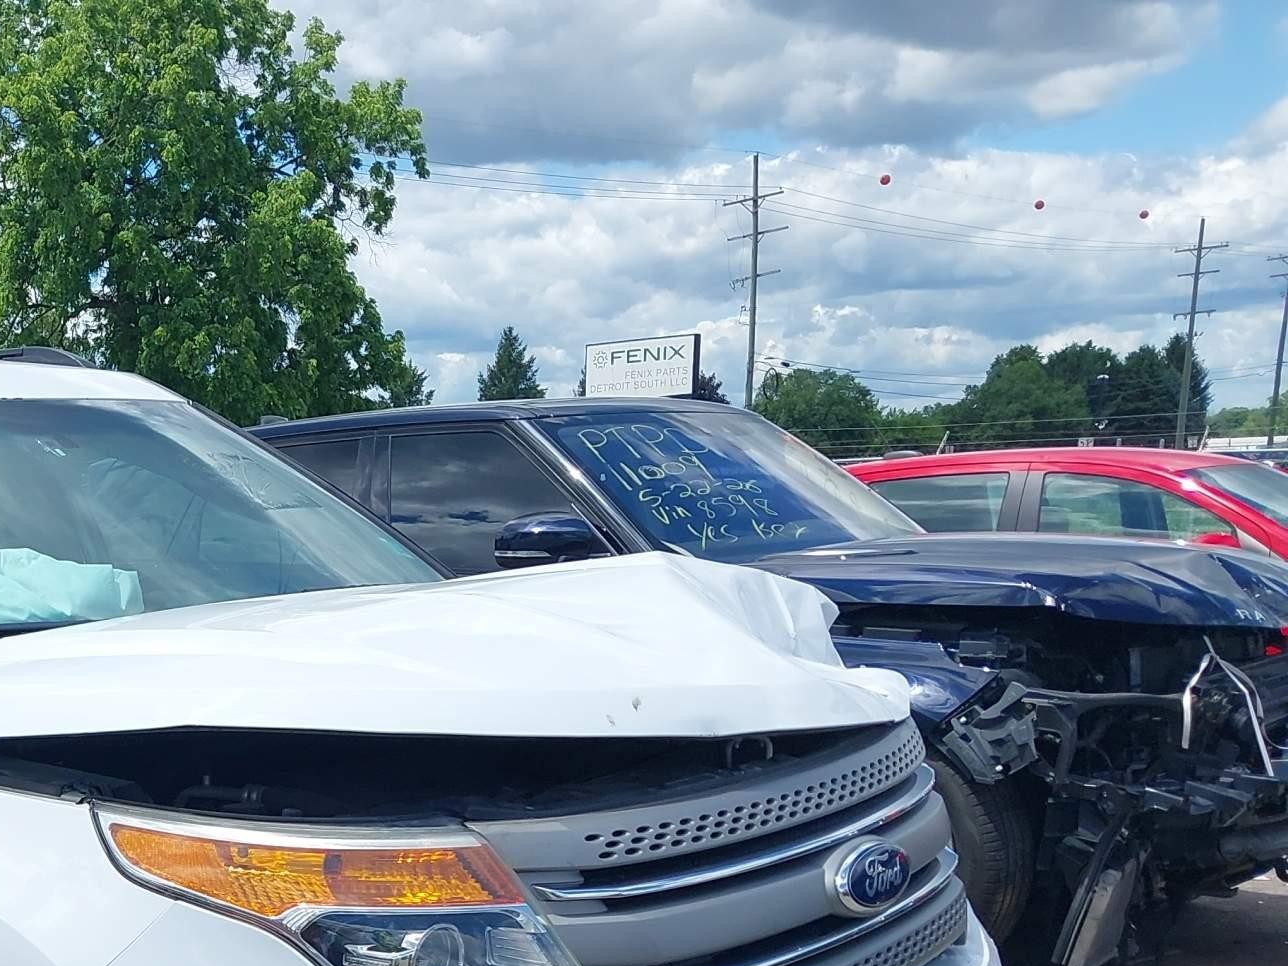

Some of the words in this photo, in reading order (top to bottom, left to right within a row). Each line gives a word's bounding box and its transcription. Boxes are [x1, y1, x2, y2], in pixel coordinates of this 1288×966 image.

[610, 344, 686, 366] FENIX
[624, 368, 654, 380] FENIX
[656, 366, 689, 377] PARTS
[590, 381, 631, 394] DETROIT
[633, 379, 667, 390] SOUTH
[669, 376, 688, 387] LLC
[865, 852, 903, 898] Ford
